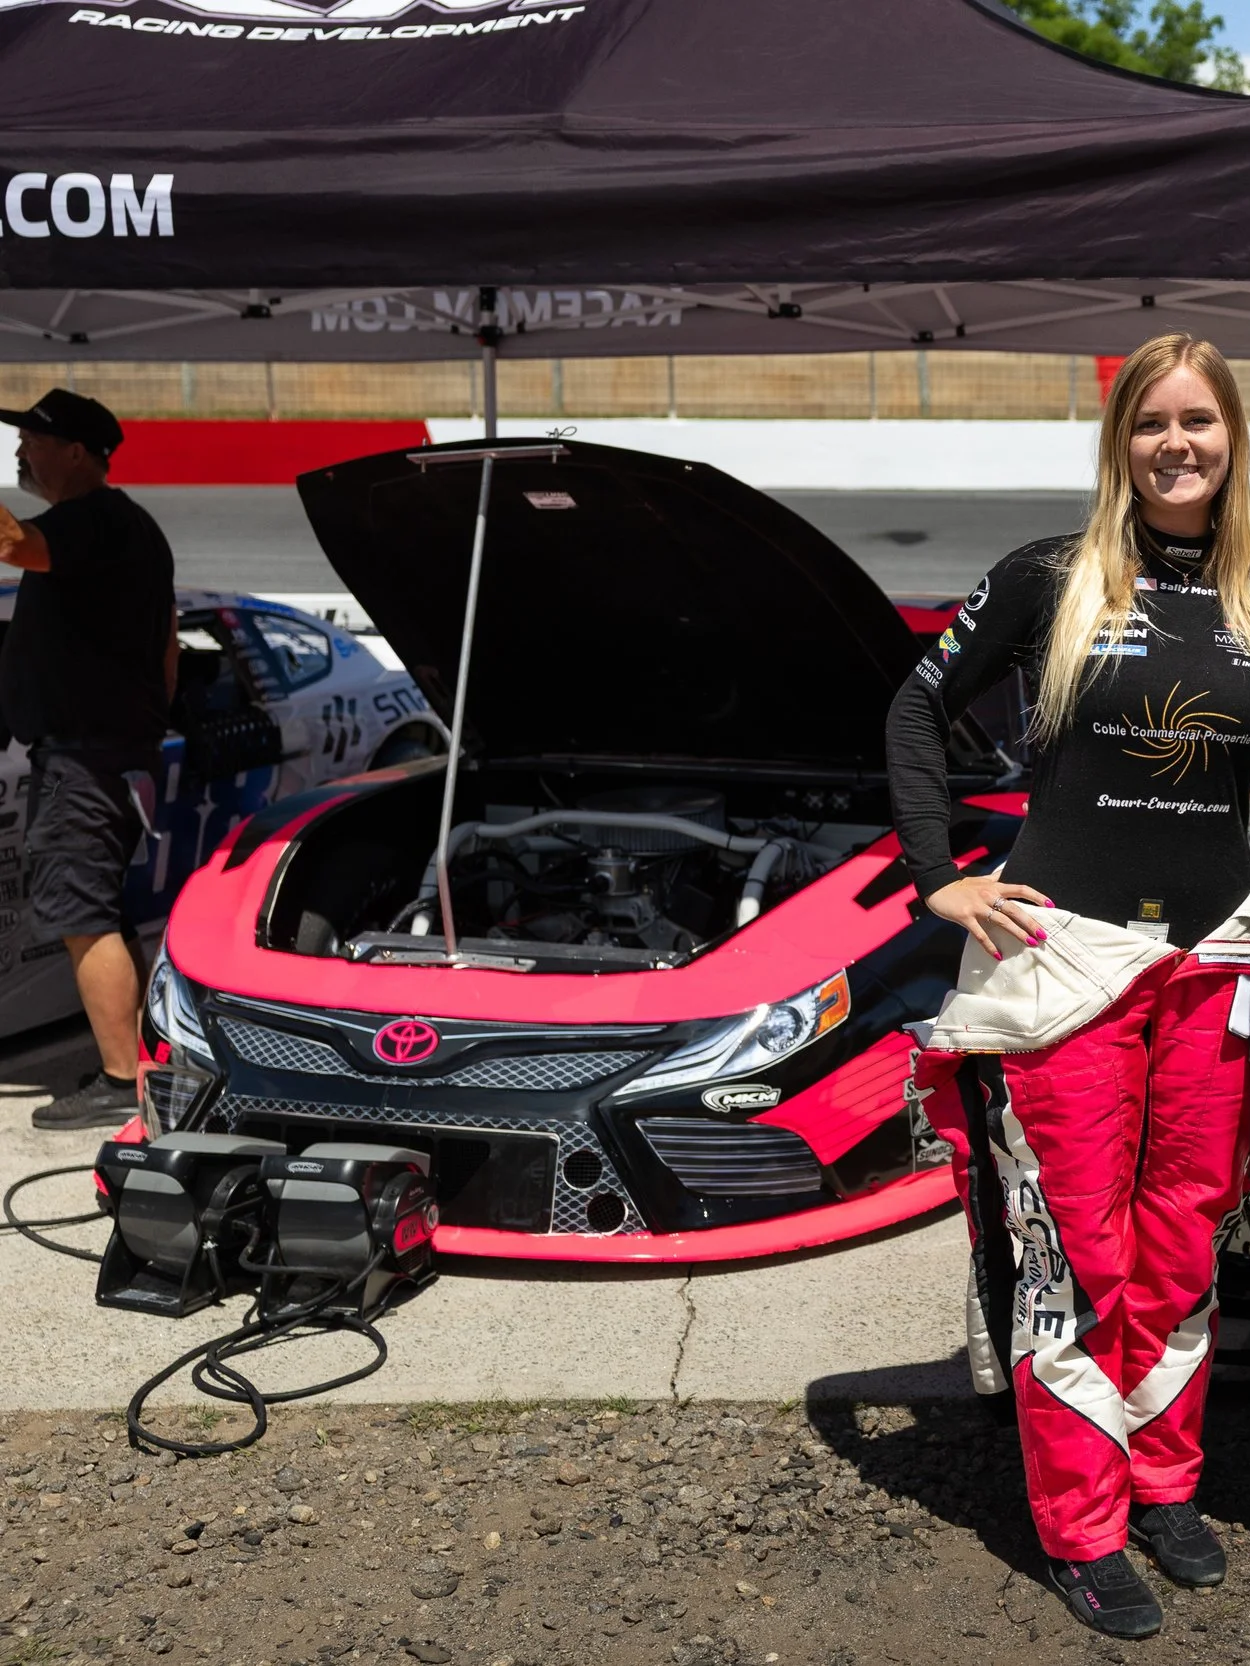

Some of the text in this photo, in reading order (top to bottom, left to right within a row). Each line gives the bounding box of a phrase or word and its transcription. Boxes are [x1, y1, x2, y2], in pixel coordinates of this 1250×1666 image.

[69, 10, 244, 39] RACING
[247, 7, 586, 41] DEVELOPMENT
[0, 172, 175, 238] COM
[1160, 582, 1218, 597] Sally Mott
[941, 634, 960, 652] NOCO
[915, 663, 940, 689] LLERIES
[921, 655, 943, 680] LMETTO
[1093, 722, 1127, 736] Coble
[1130, 725, 1201, 741] Commercial
[1097, 794, 1231, 815] Smart-Energize.com
[723, 1091, 777, 1104] MKM
[1085, 1591, 1100, 1609] GT3
